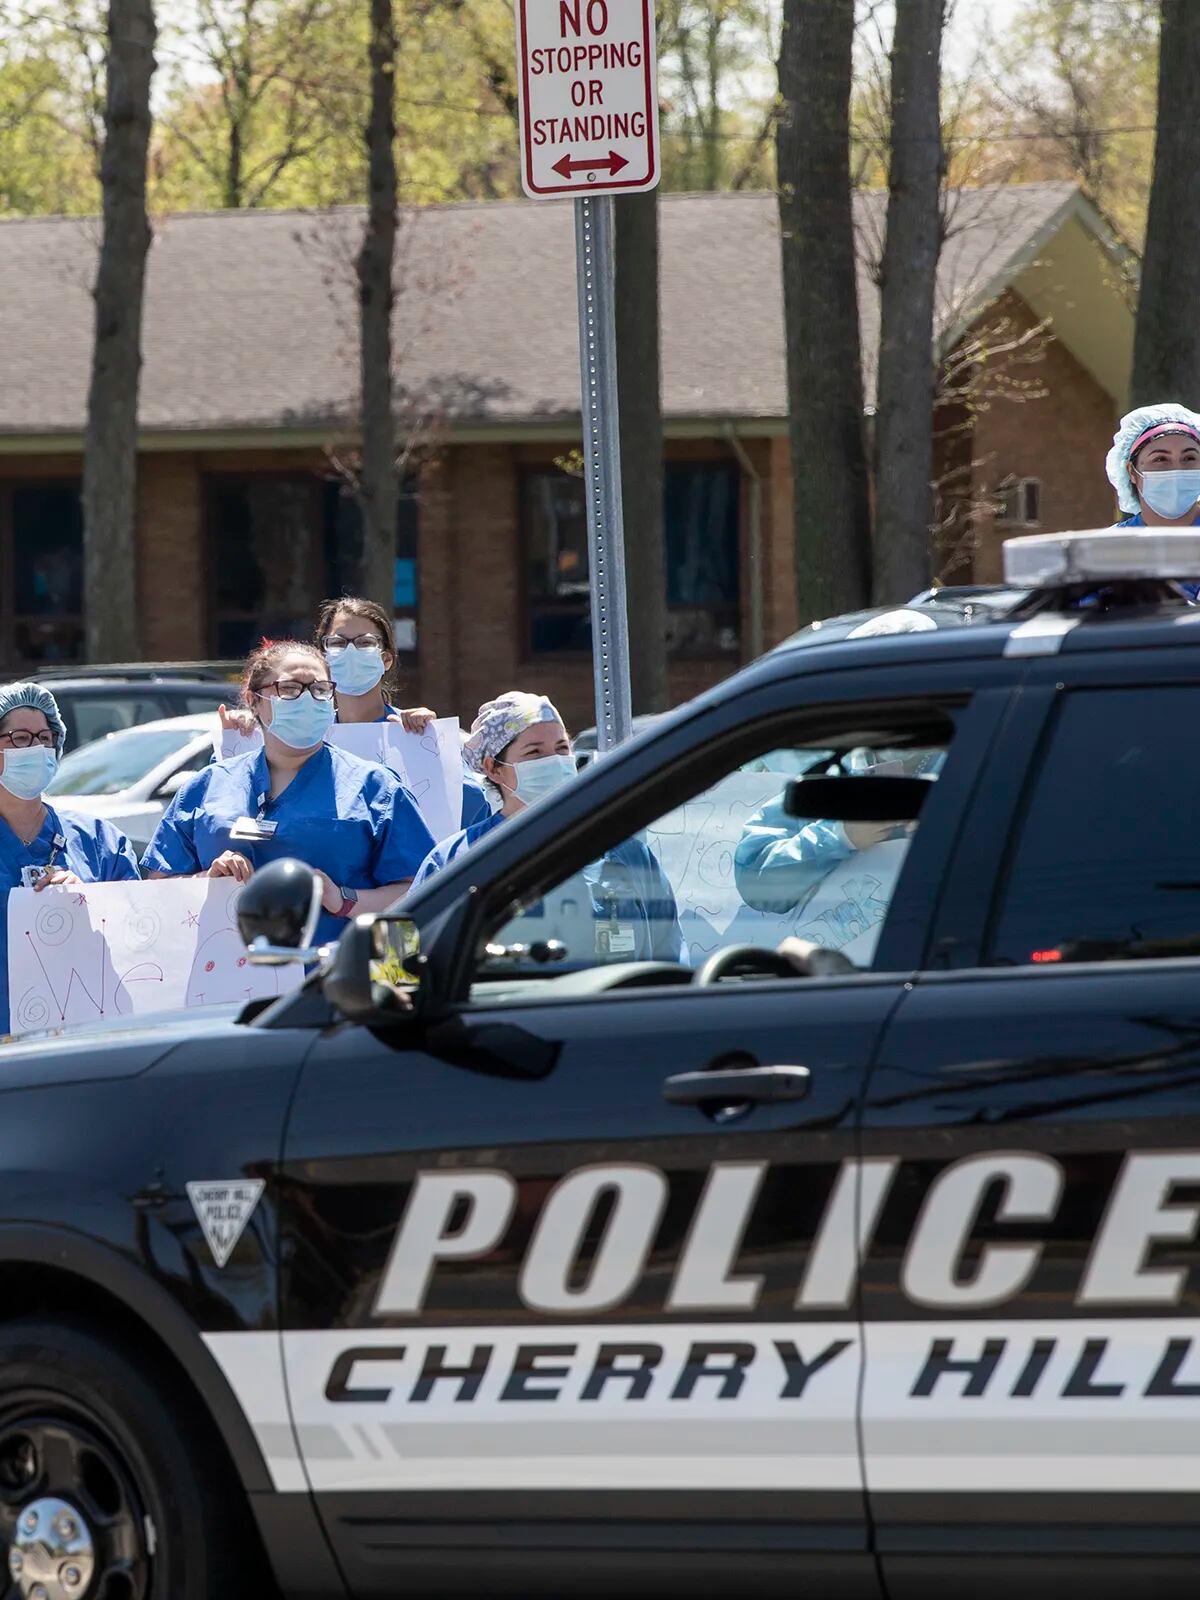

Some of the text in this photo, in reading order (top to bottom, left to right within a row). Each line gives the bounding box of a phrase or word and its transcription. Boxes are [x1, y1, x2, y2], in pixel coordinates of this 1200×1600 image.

[560, 0, 608, 38] NO
[530, 41, 641, 75] STOPPING
[571, 80, 603, 106] OR
[533, 112, 645, 145] STANDING
[371, 1149, 1200, 1317] POLICE
[323, 1336, 1200, 1404] CHERRY HILL
